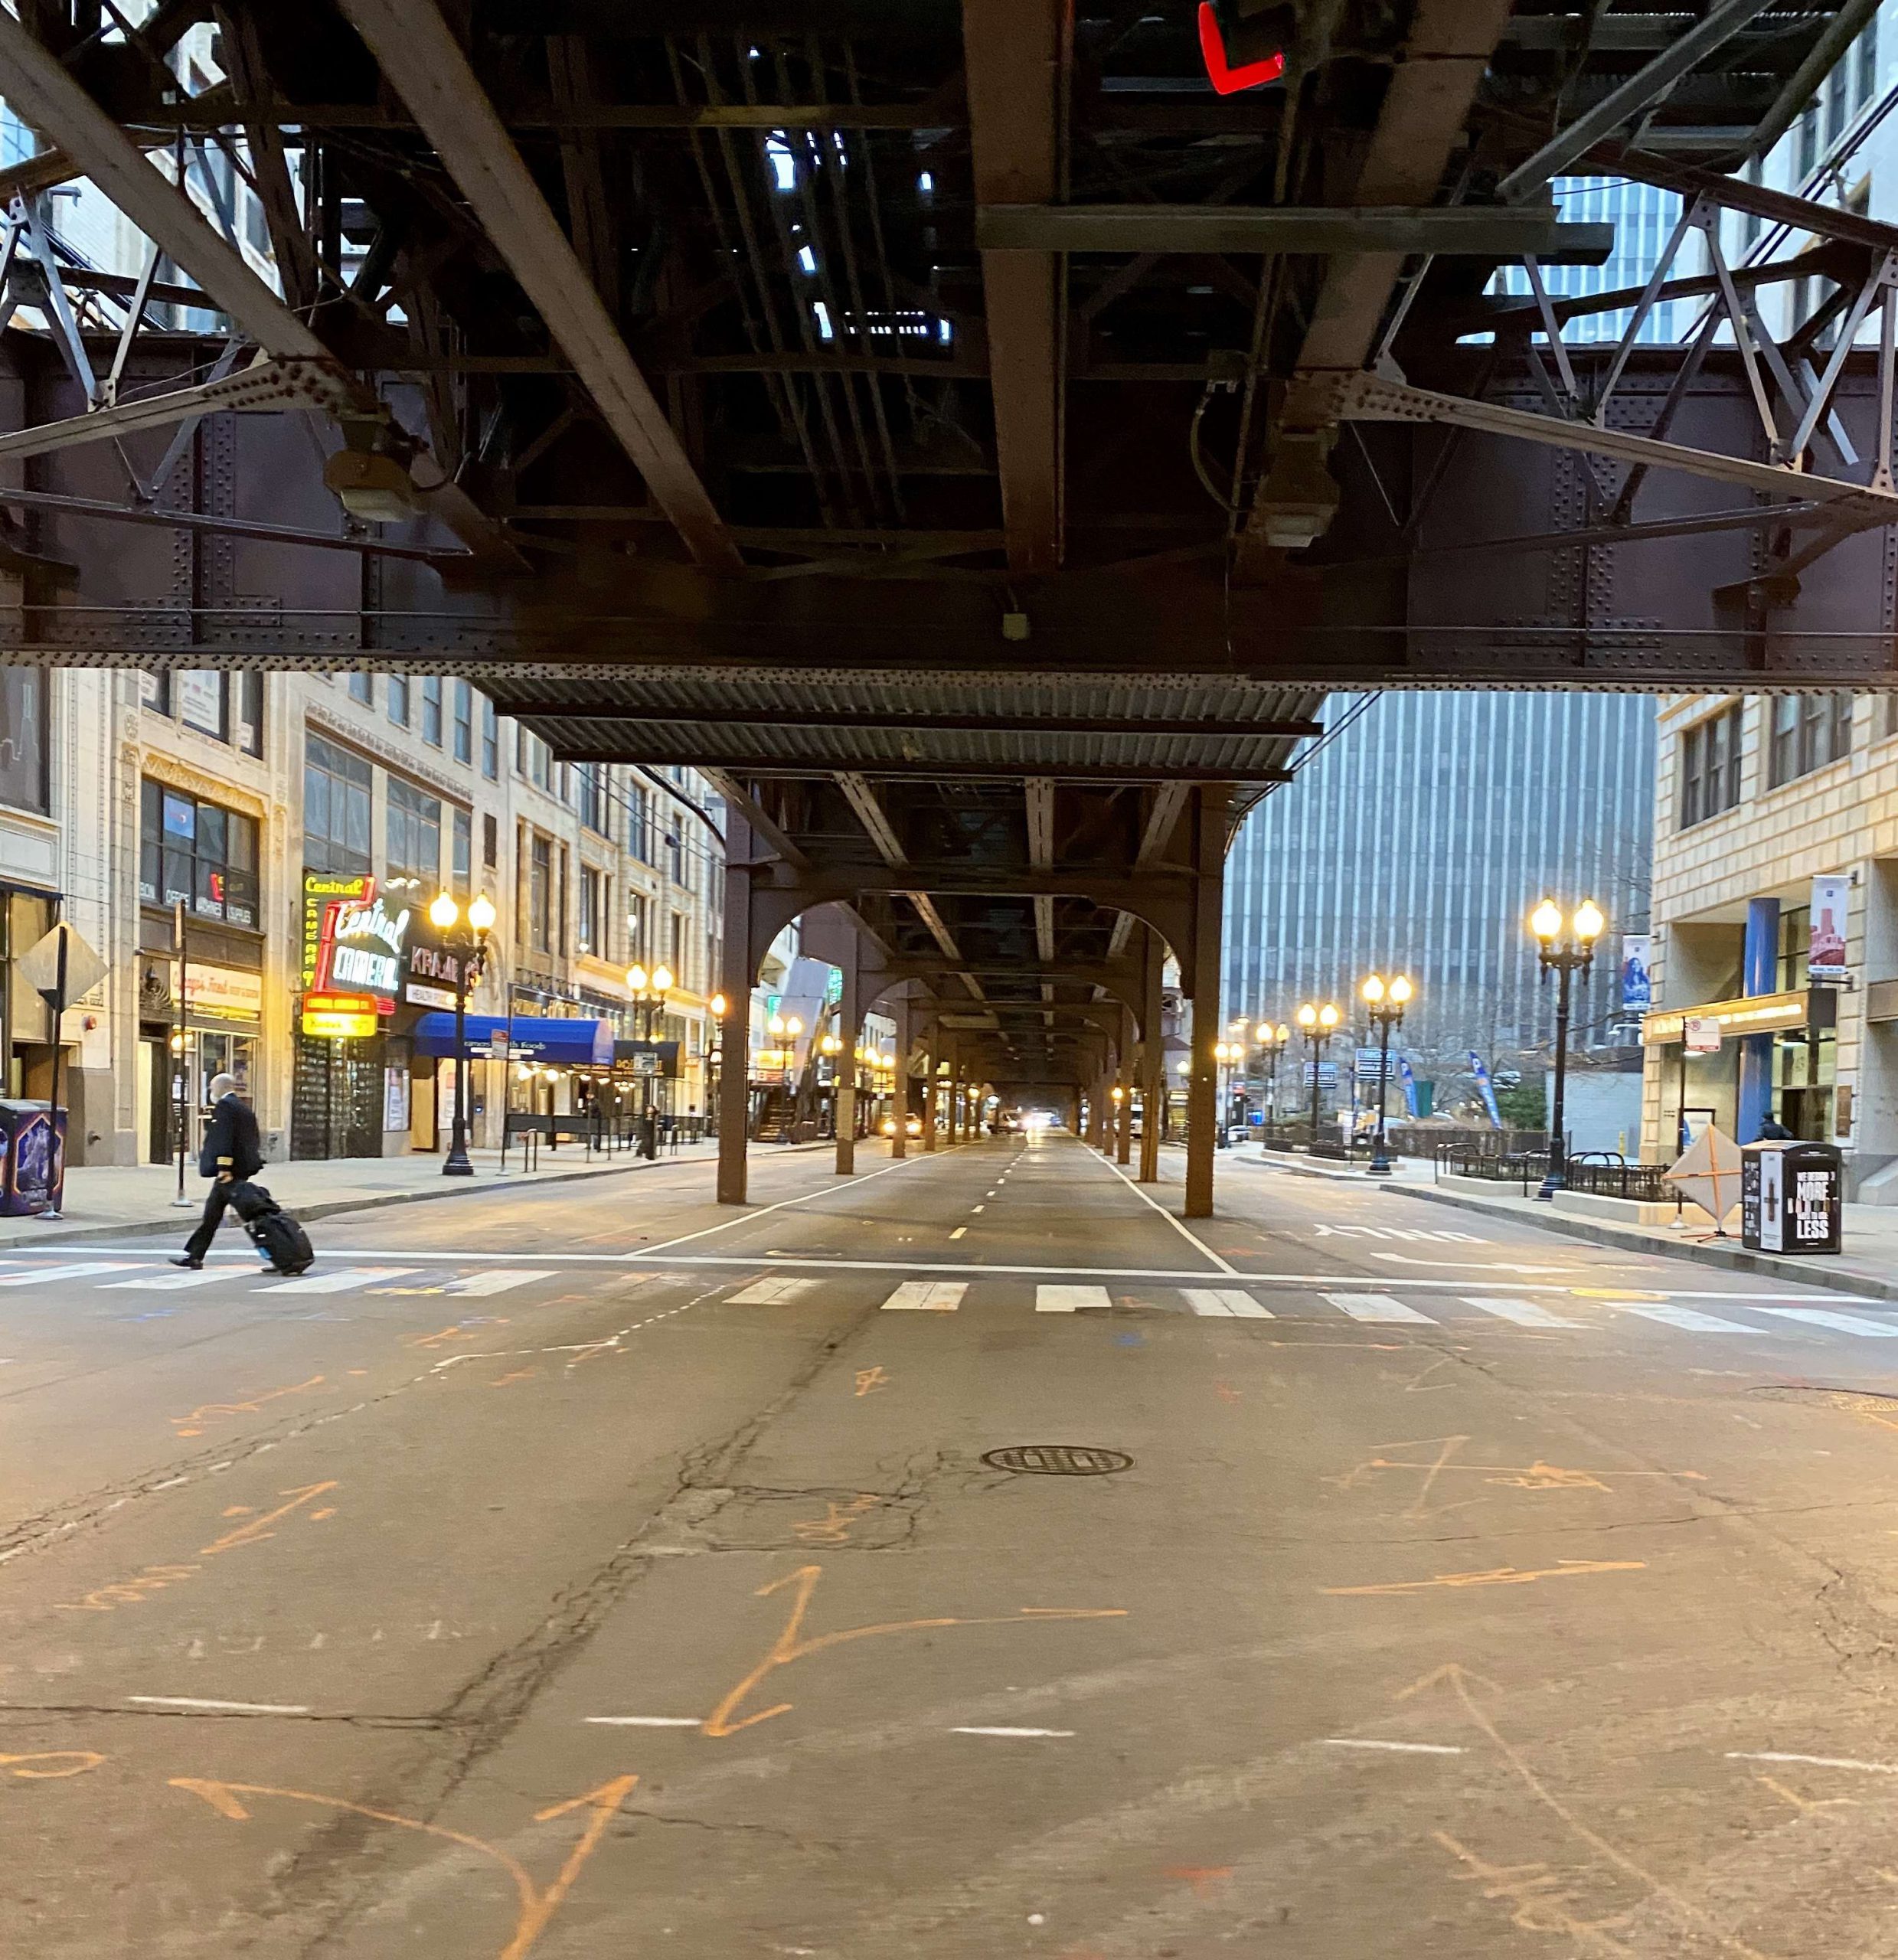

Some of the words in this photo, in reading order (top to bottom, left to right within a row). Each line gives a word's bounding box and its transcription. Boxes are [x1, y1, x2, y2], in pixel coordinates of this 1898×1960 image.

[305, 876, 364, 894] Central
[335, 898, 410, 955] Central
[333, 946, 399, 991] CAMERA
[1472, 1058, 1482, 1073] P
[1796, 1220, 1829, 1239] LESS
